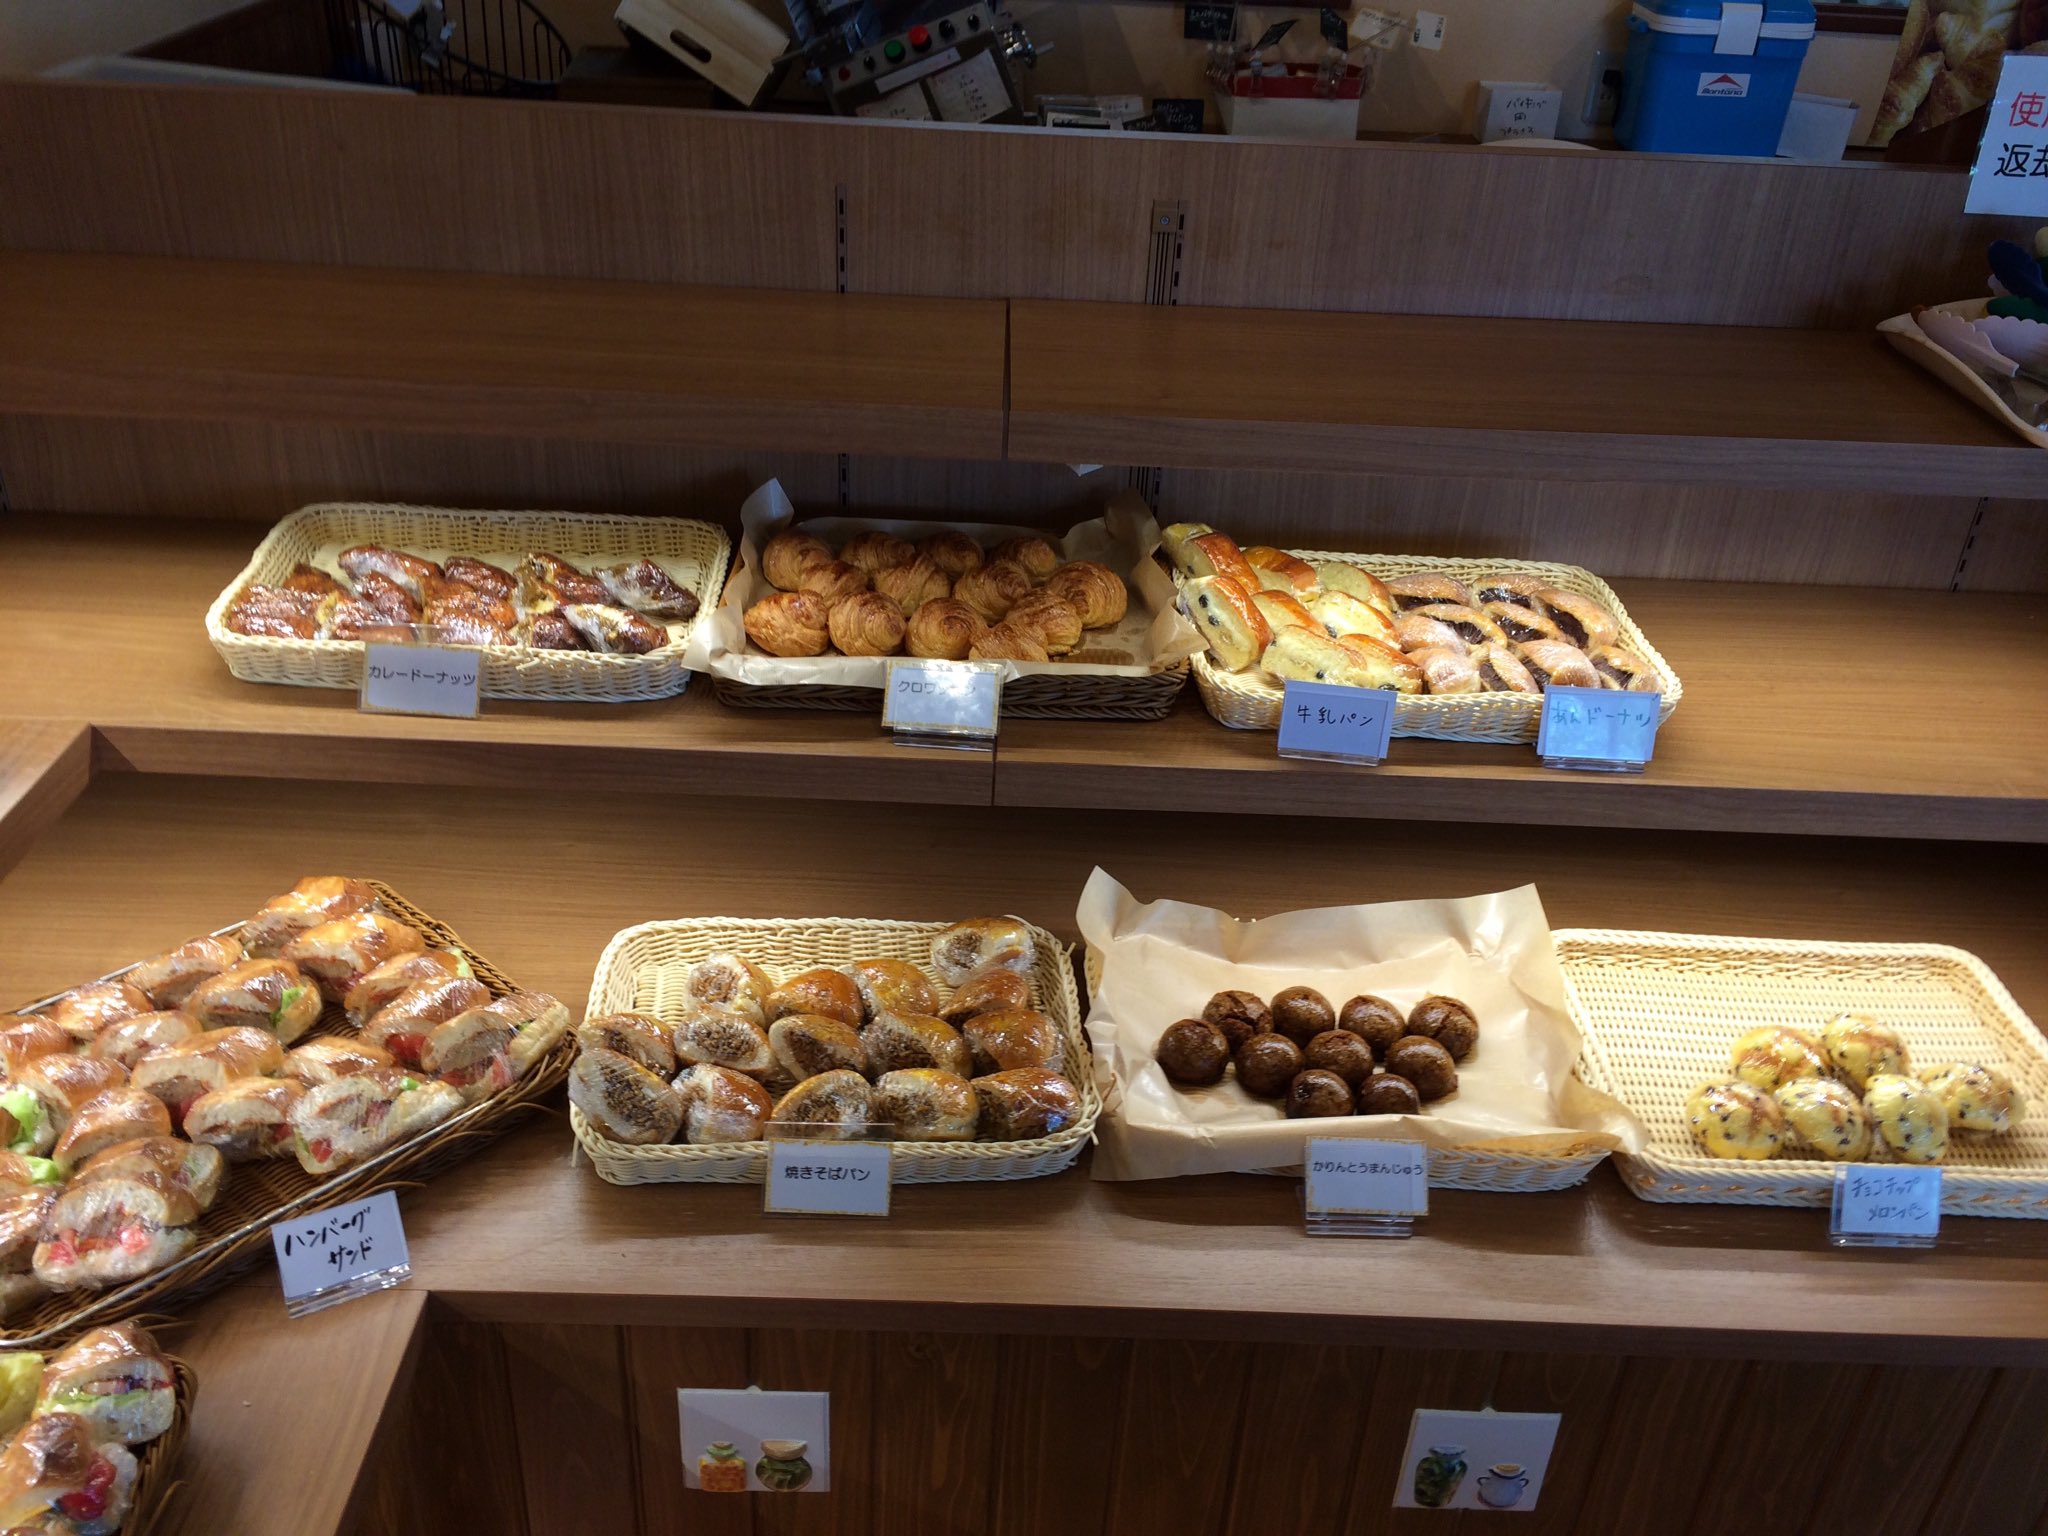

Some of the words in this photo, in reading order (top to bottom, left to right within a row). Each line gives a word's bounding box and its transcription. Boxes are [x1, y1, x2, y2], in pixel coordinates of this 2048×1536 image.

[2009, 91, 2048, 128] 使
[368, 665, 476, 686] カレードーナッツ
[1296, 704, 1374, 727] 牛乳パン
[1551, 701, 1652, 727] あんドーナツ
[784, 1165, 871, 1182] 焼きそばパン
[1312, 1160, 1423, 1176] かりんとうまんじゅう
[1851, 1176, 1921, 1198] チョコチップ
[1868, 1204, 1929, 1222] メロンパン
[284, 1206, 371, 1256] ハンバーグ
[327, 1237, 375, 1272] サンド
